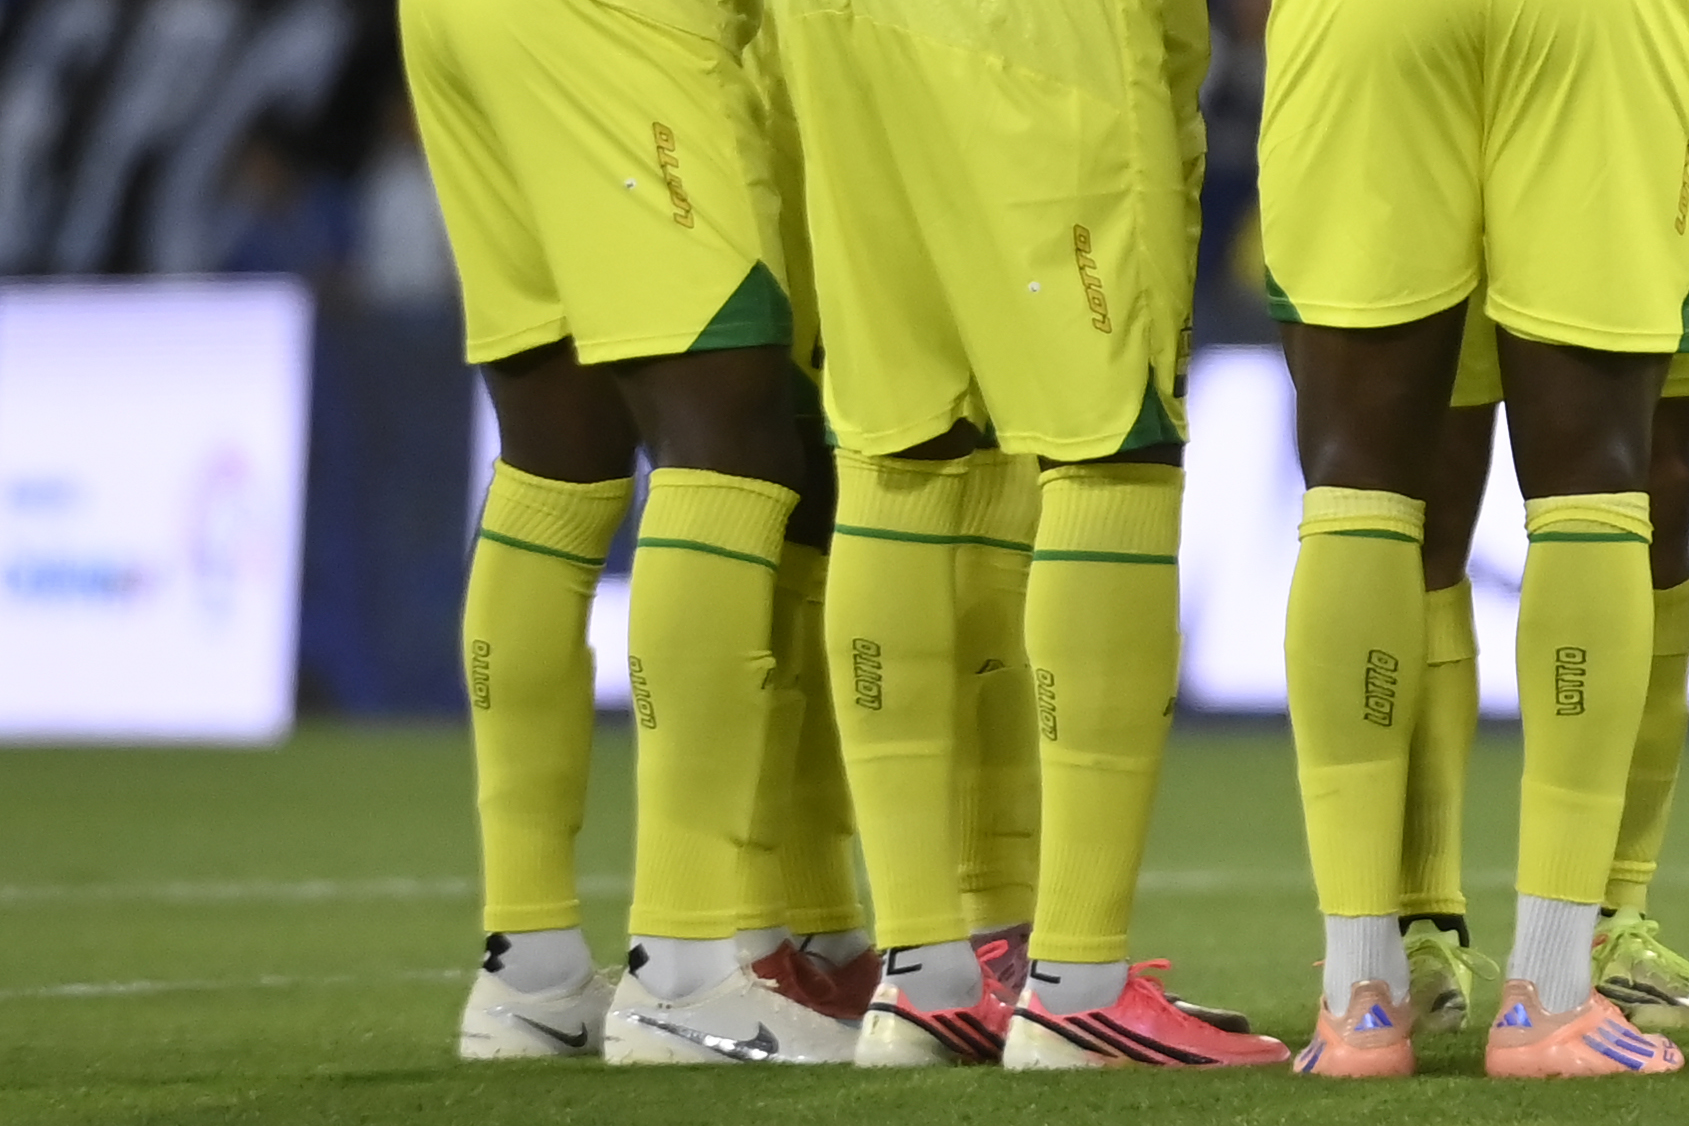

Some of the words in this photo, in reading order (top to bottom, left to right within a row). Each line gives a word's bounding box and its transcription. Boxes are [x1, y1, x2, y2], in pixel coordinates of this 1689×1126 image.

[1073, 223, 1113, 334] LOTTO
[853, 638, 882, 711] LOTTO
[1363, 649, 1399, 727] LOTTO
[1555, 646, 1587, 716] LOTTO
